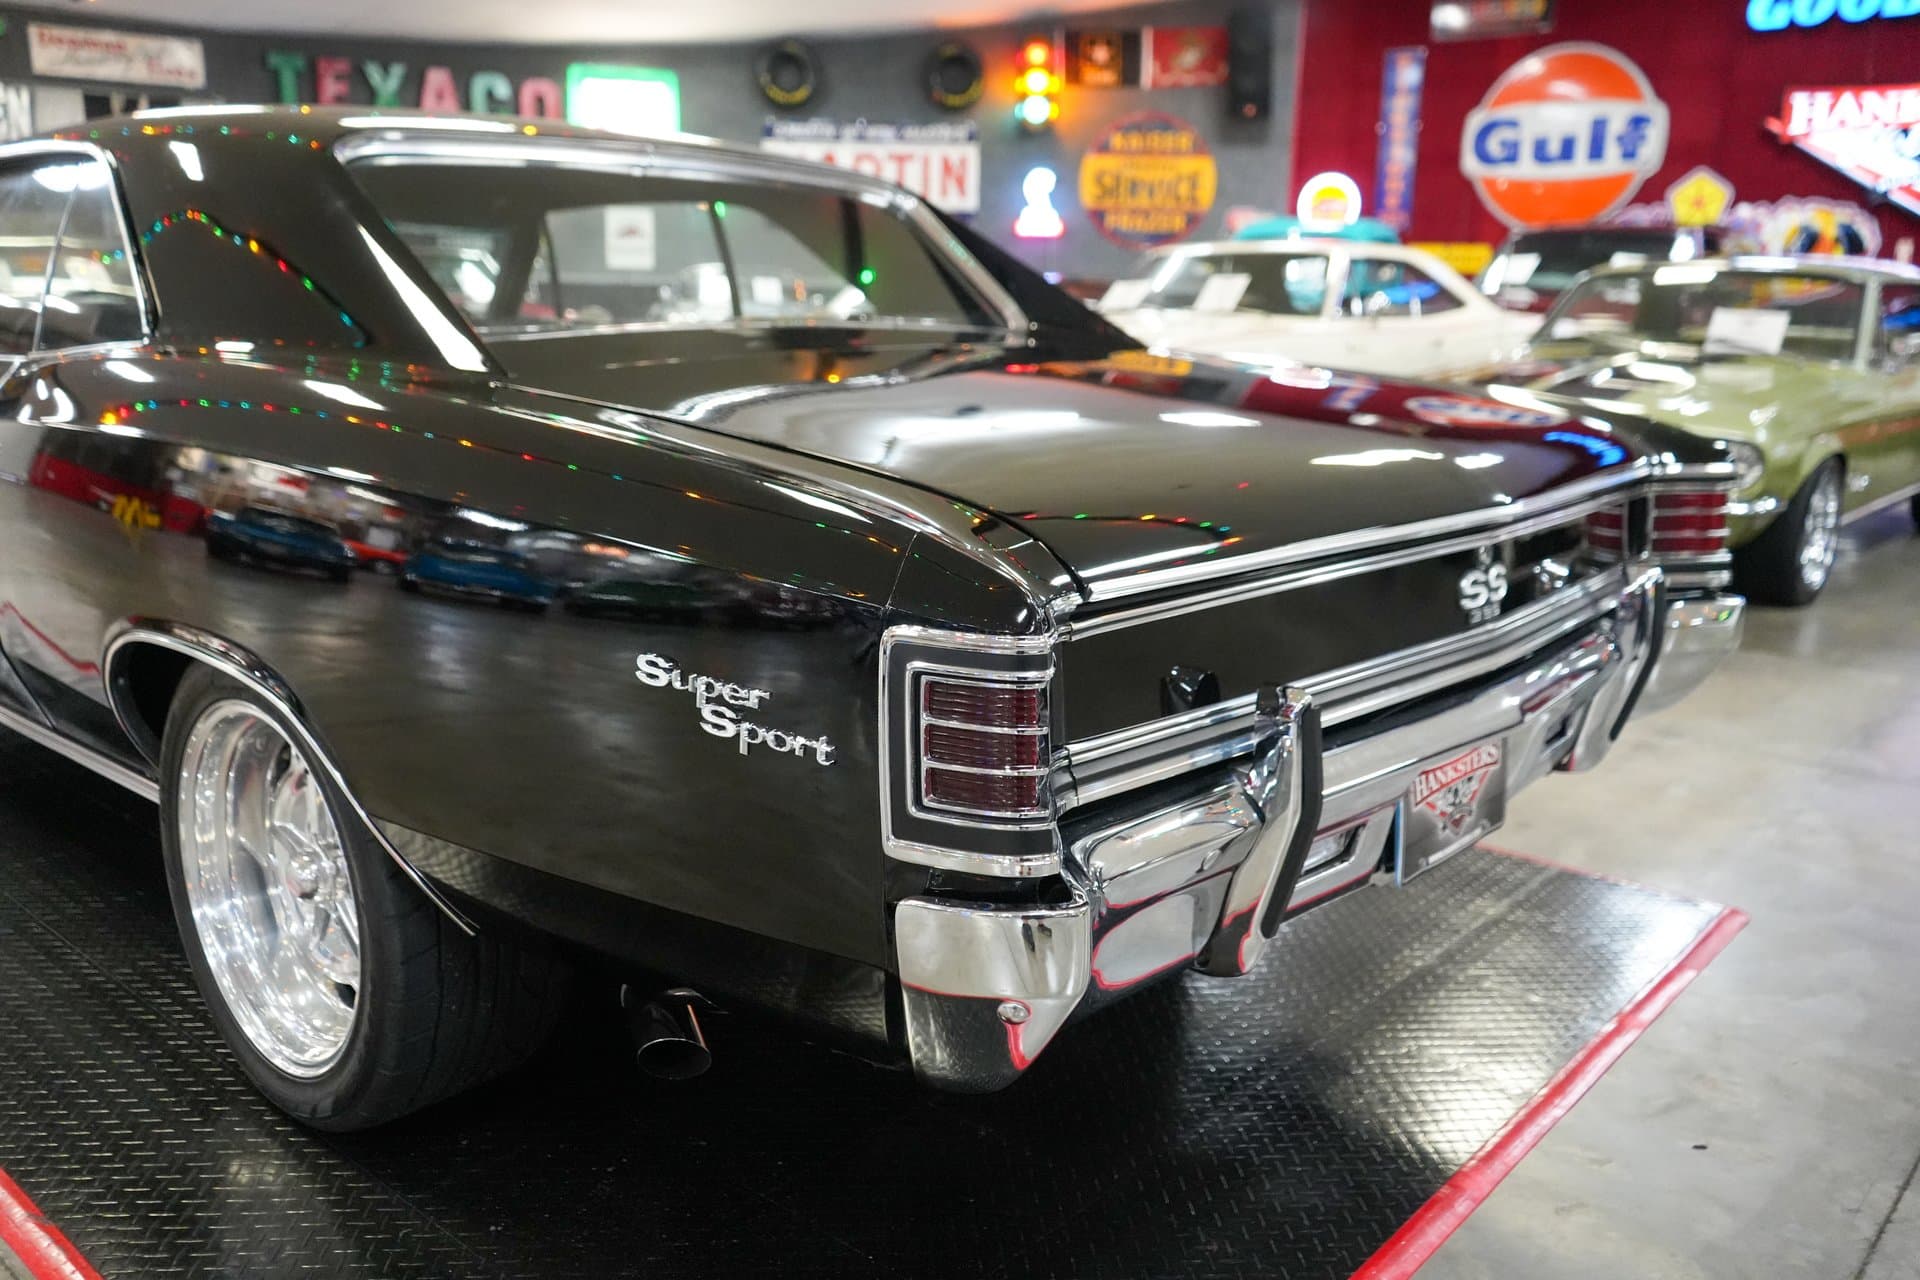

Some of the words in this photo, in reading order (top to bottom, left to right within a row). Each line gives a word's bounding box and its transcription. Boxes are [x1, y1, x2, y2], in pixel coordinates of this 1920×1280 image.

[266, 53, 564, 121] TEXACO
[1475, 114, 1652, 164] Gulf
[1460, 564, 1508, 610] SS
[635, 653, 770, 709] Super
[700, 704, 835, 766] Sport
[1414, 745, 1499, 804] HANKSTERS
